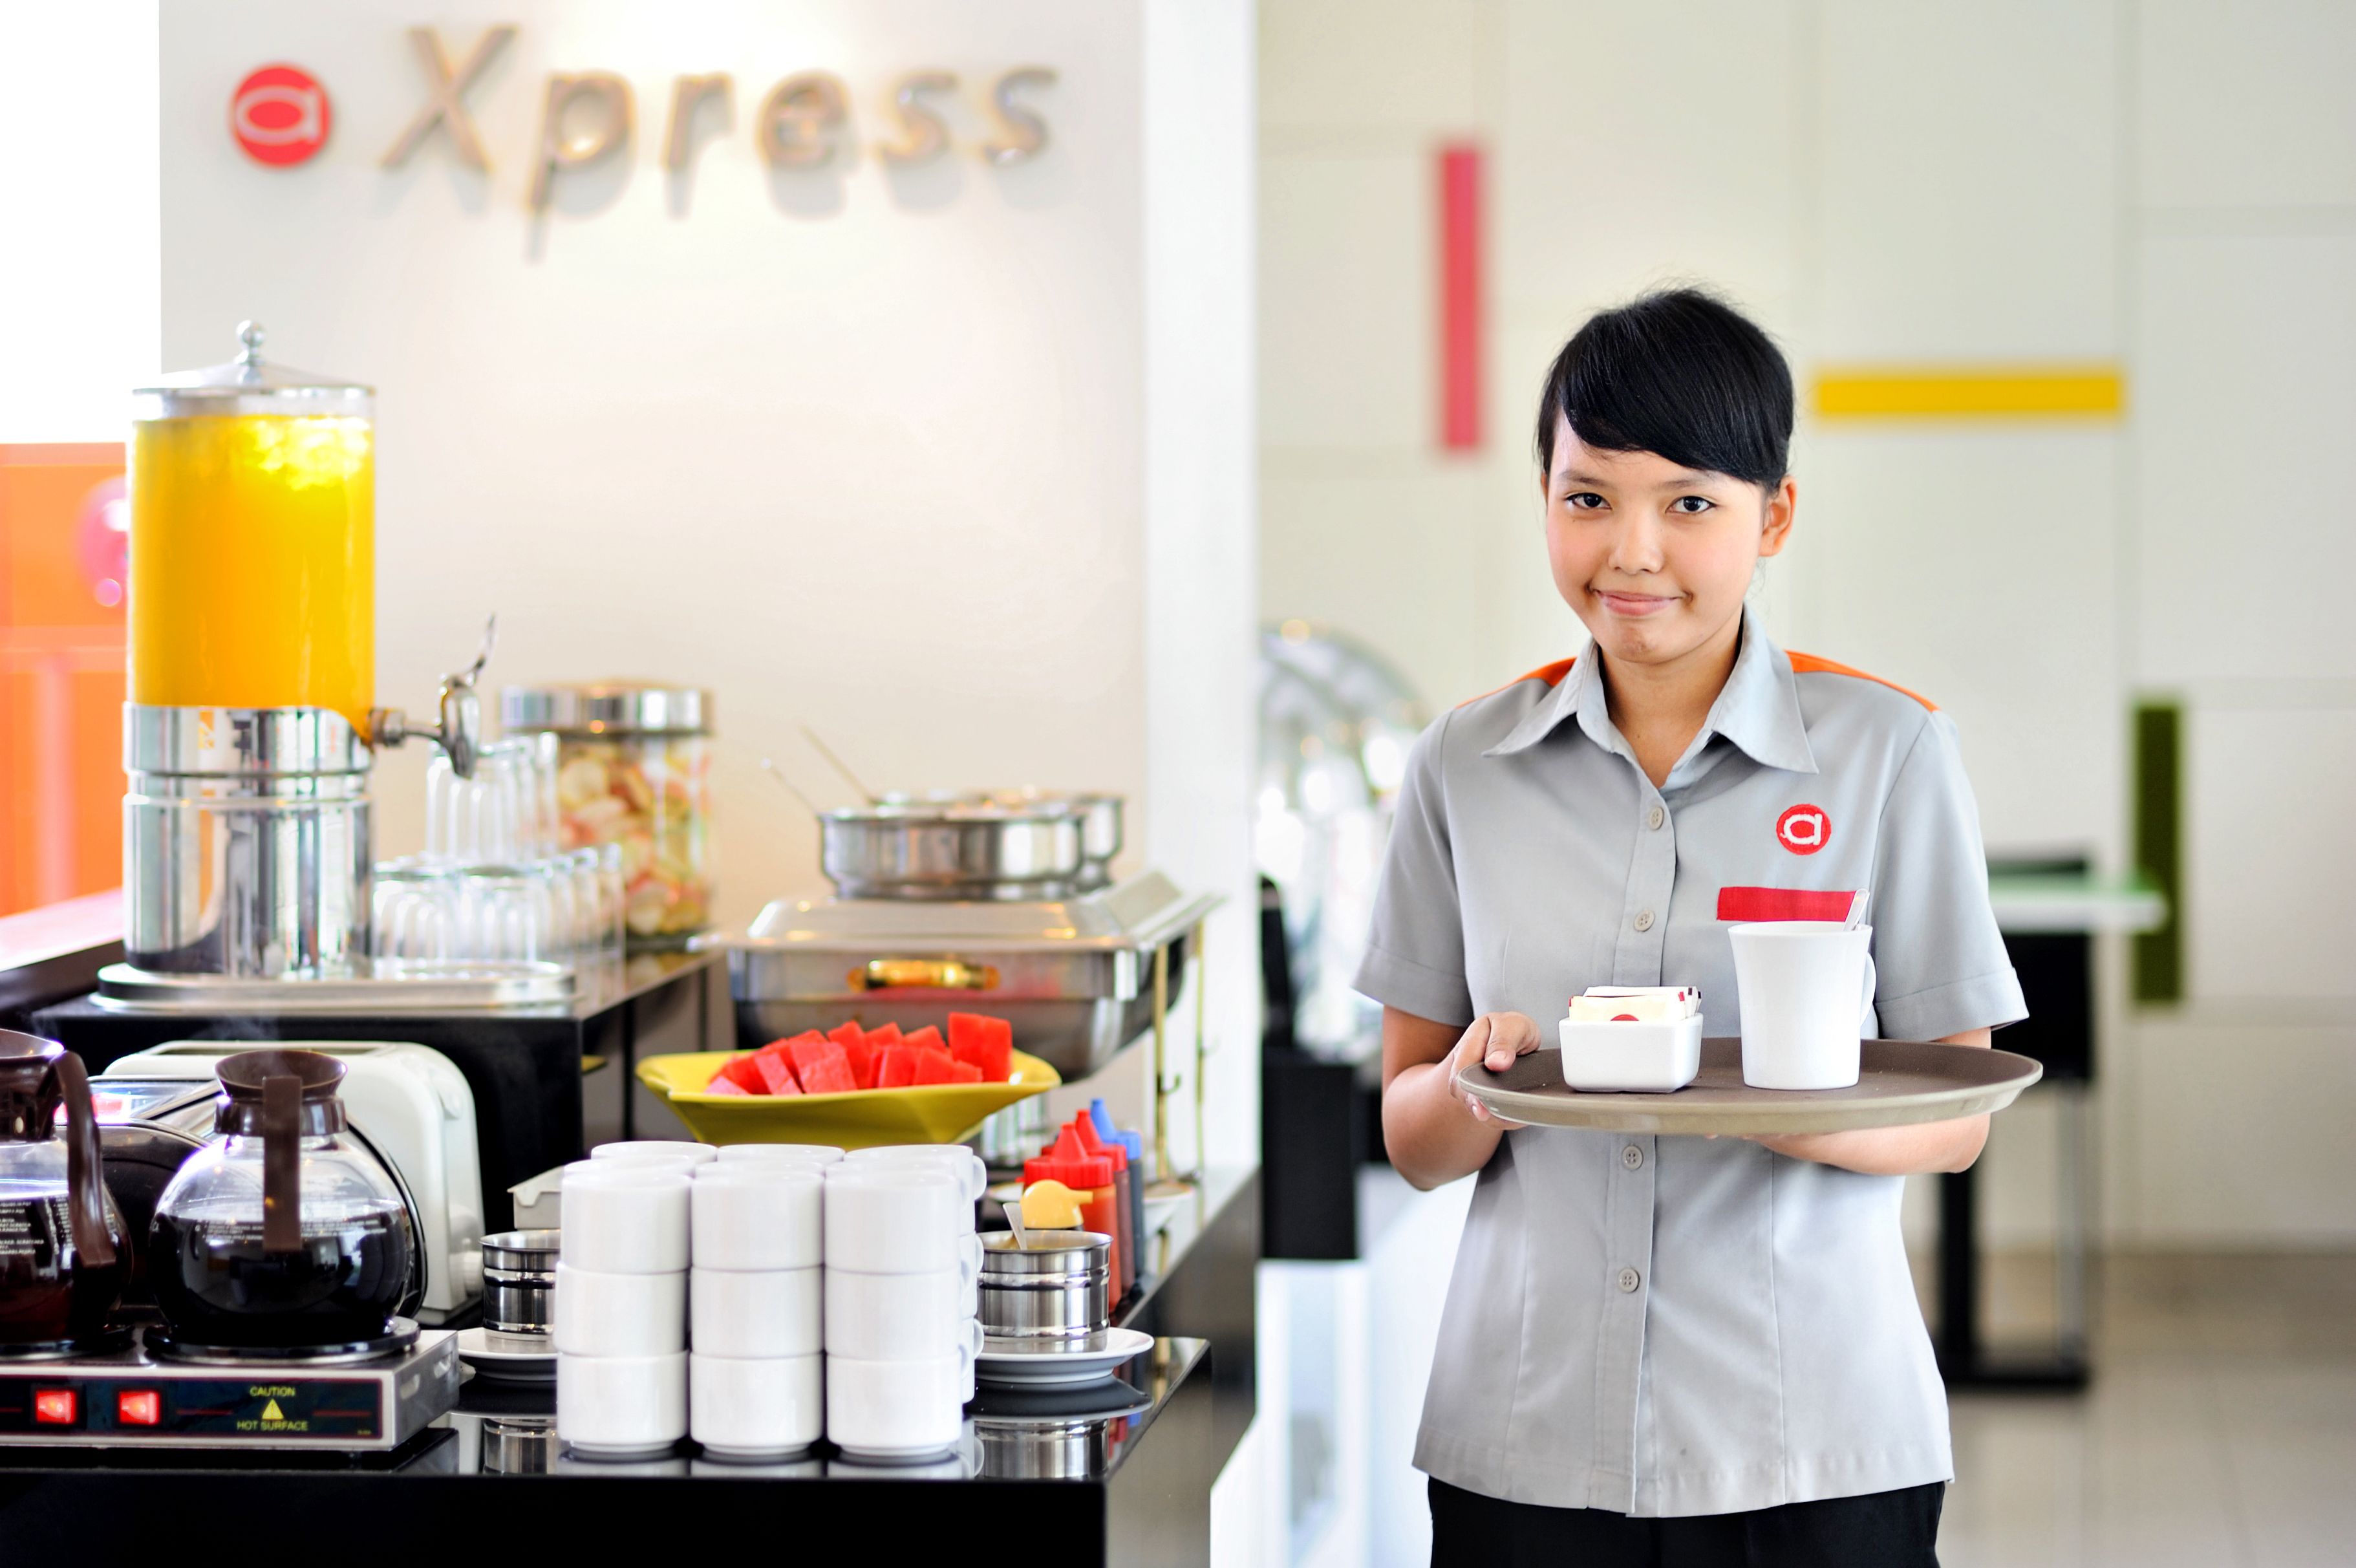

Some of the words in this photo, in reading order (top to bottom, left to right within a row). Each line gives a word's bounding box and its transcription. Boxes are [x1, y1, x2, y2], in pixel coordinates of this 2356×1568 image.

[378, 24, 1060, 215] Xpress
[250, 1386, 295, 1397] CAUTION
[237, 1421, 258, 1431] HOT
[261, 1421, 308, 1431] SURFACE
